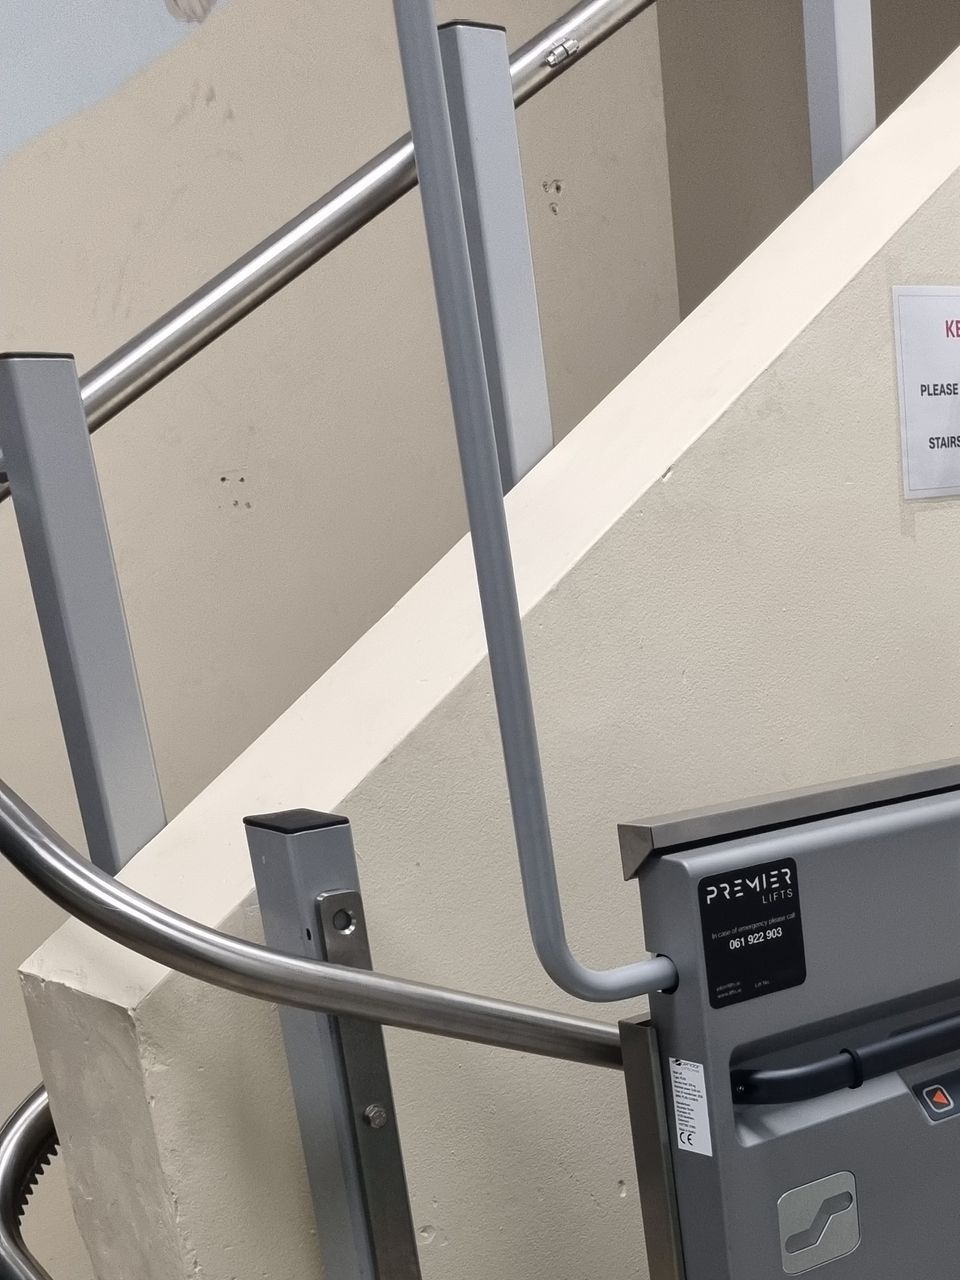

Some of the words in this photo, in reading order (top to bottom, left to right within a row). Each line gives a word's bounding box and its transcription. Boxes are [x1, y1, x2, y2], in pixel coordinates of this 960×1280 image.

[920, 383, 959, 397] PLEASE
[706, 868, 792, 905] PREMIER
[761, 888, 794, 904] LIFTS
[729, 937, 745, 950] 061
[747, 931, 765, 945] 922
[765, 926, 783, 940] 903
